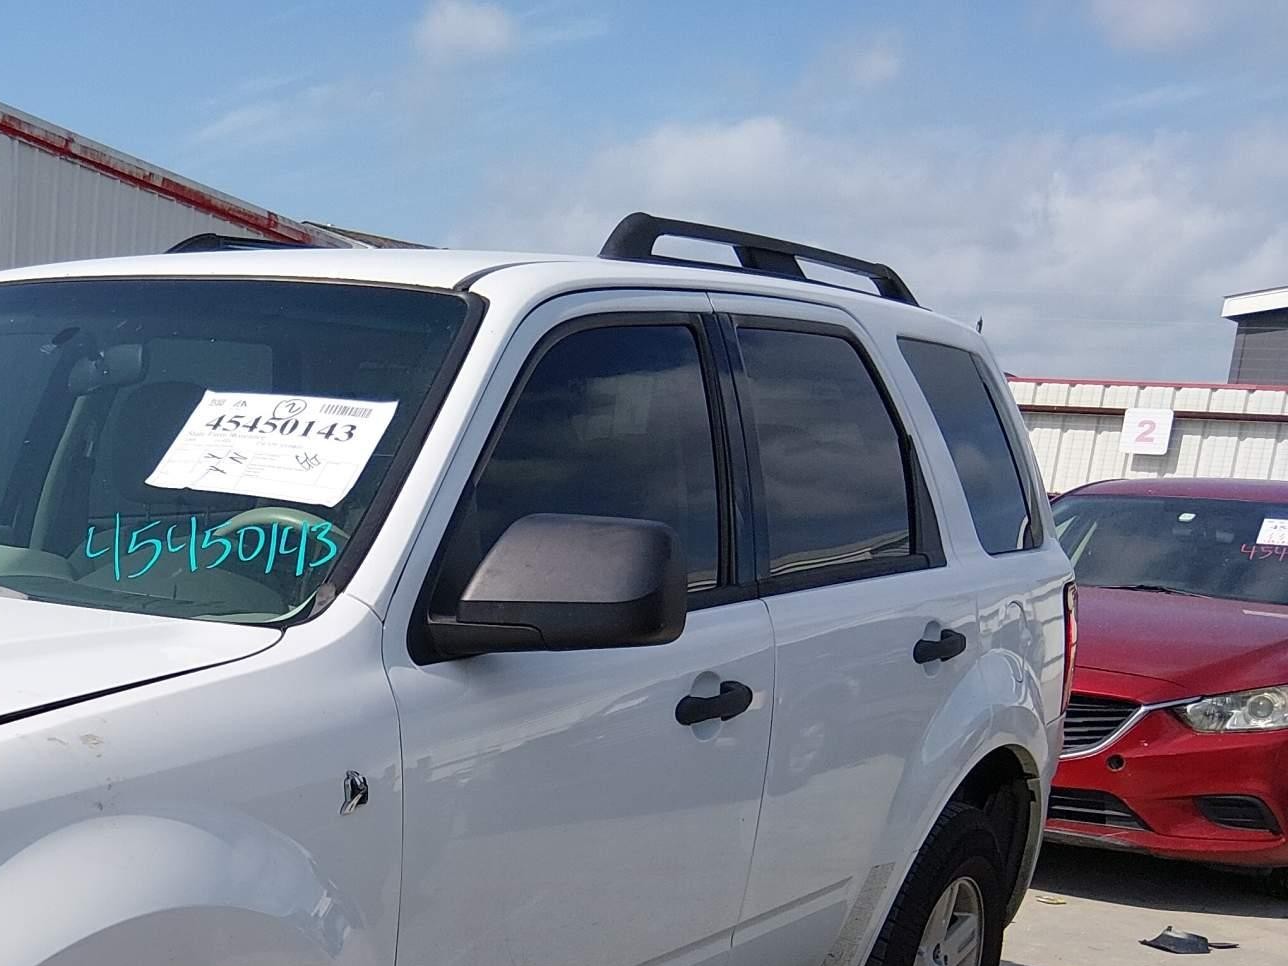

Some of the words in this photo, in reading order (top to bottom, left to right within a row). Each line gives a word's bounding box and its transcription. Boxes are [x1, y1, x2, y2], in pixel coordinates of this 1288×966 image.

[205, 414, 357, 442] 45450143
[1136, 419, 1157, 442] 2
[86, 512, 338, 582] 45450143
